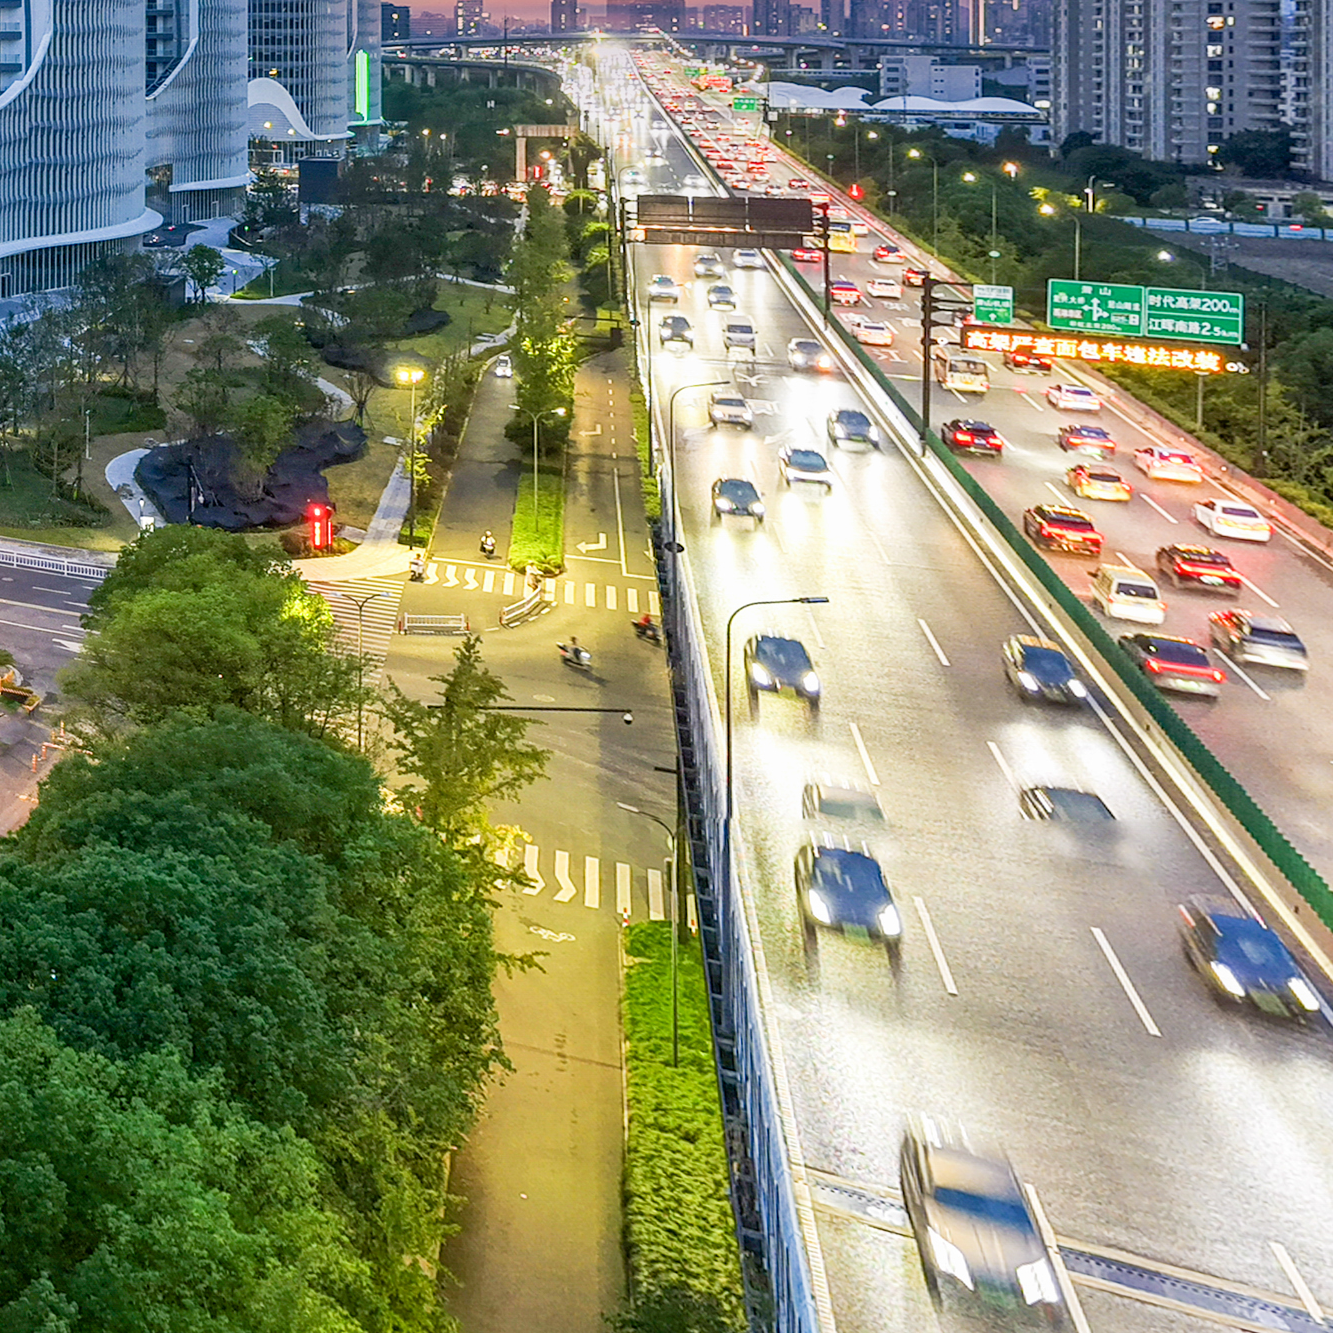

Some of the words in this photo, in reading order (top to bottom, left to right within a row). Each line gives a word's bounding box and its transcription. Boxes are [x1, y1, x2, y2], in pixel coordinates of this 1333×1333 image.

[966, 330, 1221, 372] 高架严查面包车违法改装
